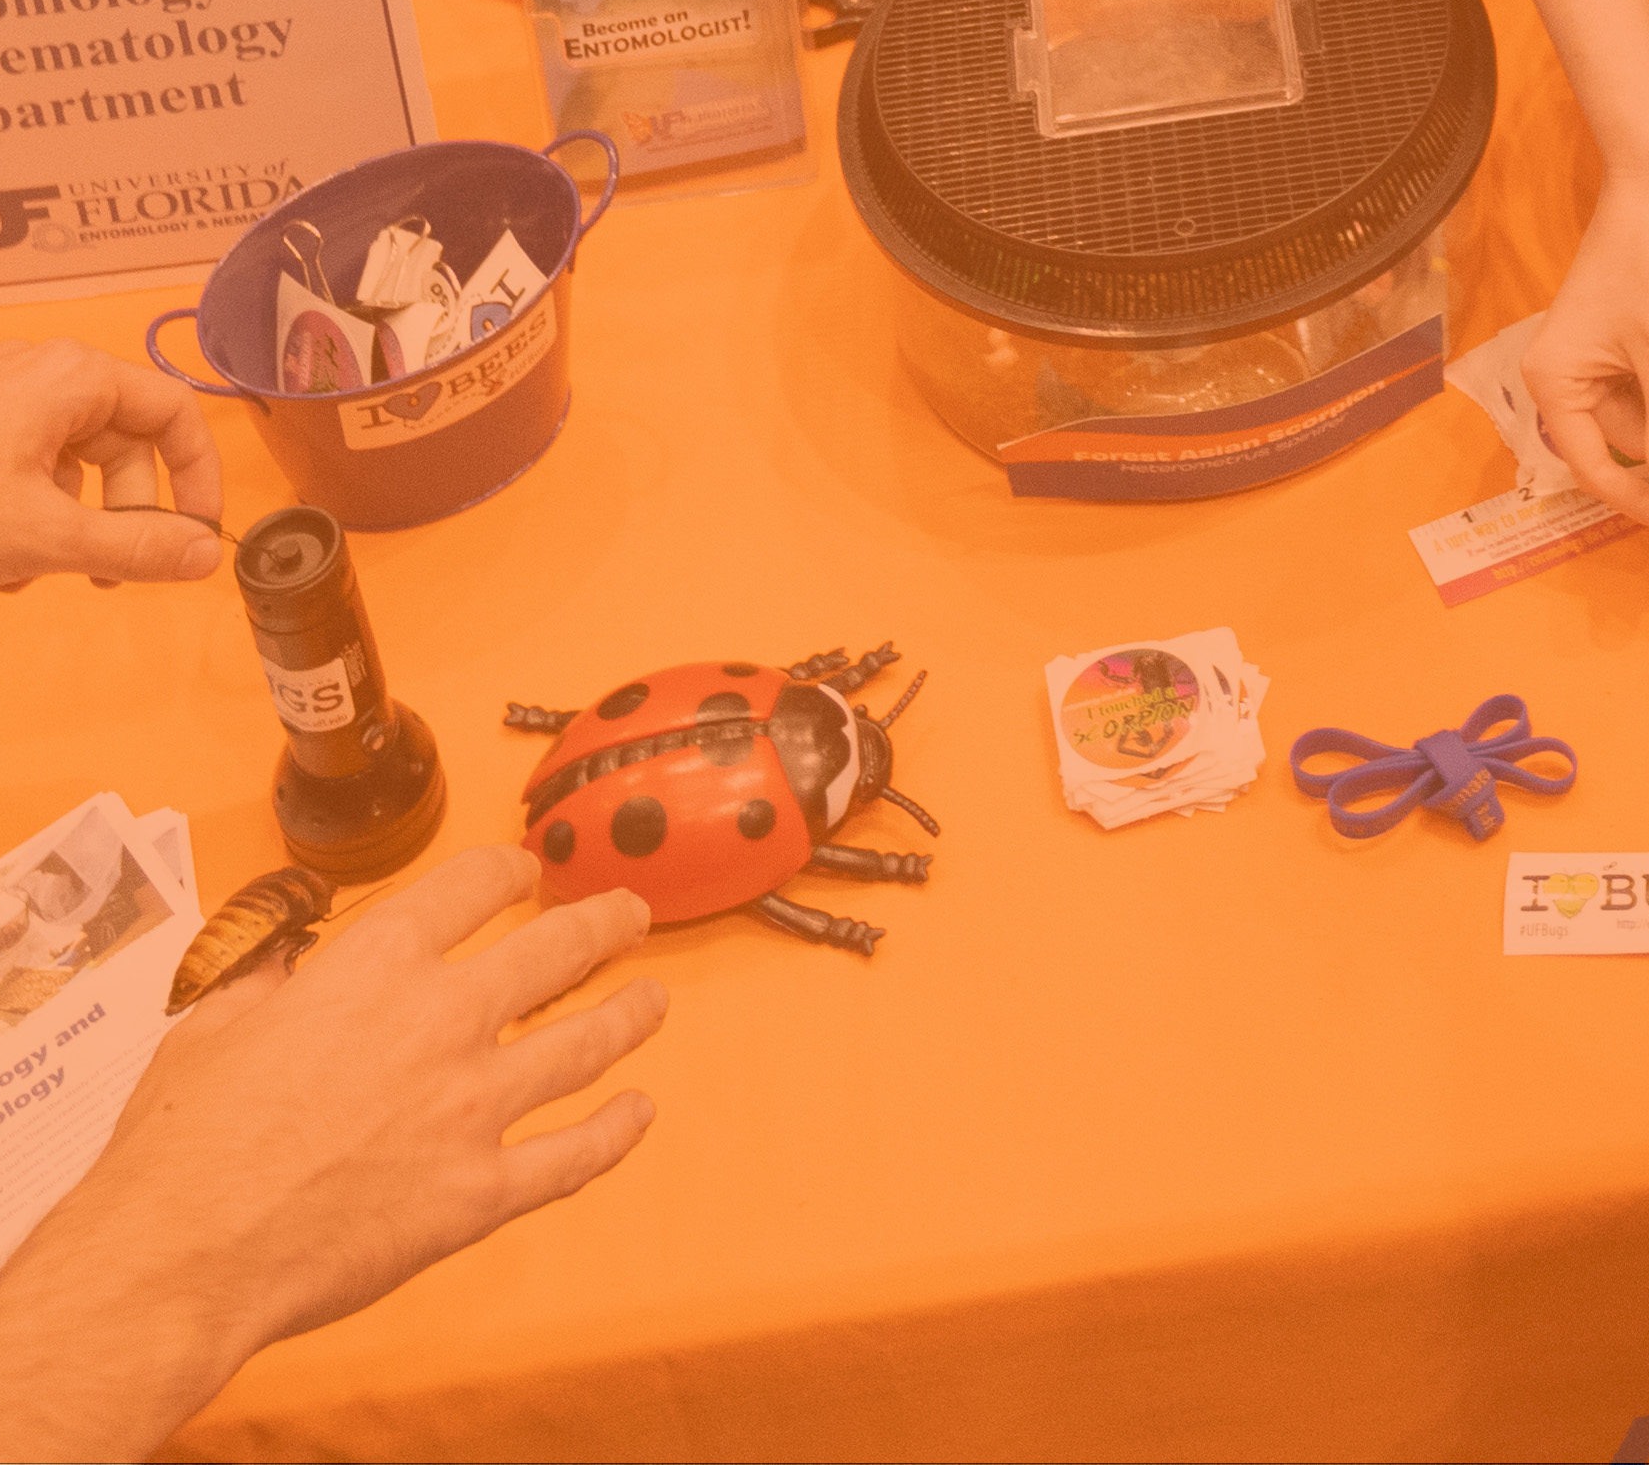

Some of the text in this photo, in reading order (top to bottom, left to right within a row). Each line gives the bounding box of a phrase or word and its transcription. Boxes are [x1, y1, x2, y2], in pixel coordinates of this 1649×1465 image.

[564, 8, 754, 61] ENTOMOLOGIST!
[581, 8, 690, 40] Become an
[66, 161, 255, 195] UNIVERSITY
[261, 157, 291, 178] of
[78, 220, 191, 245] ENTOMOLOGY
[195, 217, 209, 232] &
[447, 310, 550, 395] BEES
[1072, 378, 1388, 464] Forest Asian Scorpion
[1460, 486, 1536, 525] 1 2
[1444, 530, 1471, 550] sure
[1471, 519, 1500, 540] way
[1499, 512, 1517, 530] to
[1518, 922, 1570, 940] #UFBugs
[53, 1001, 107, 1048] and
